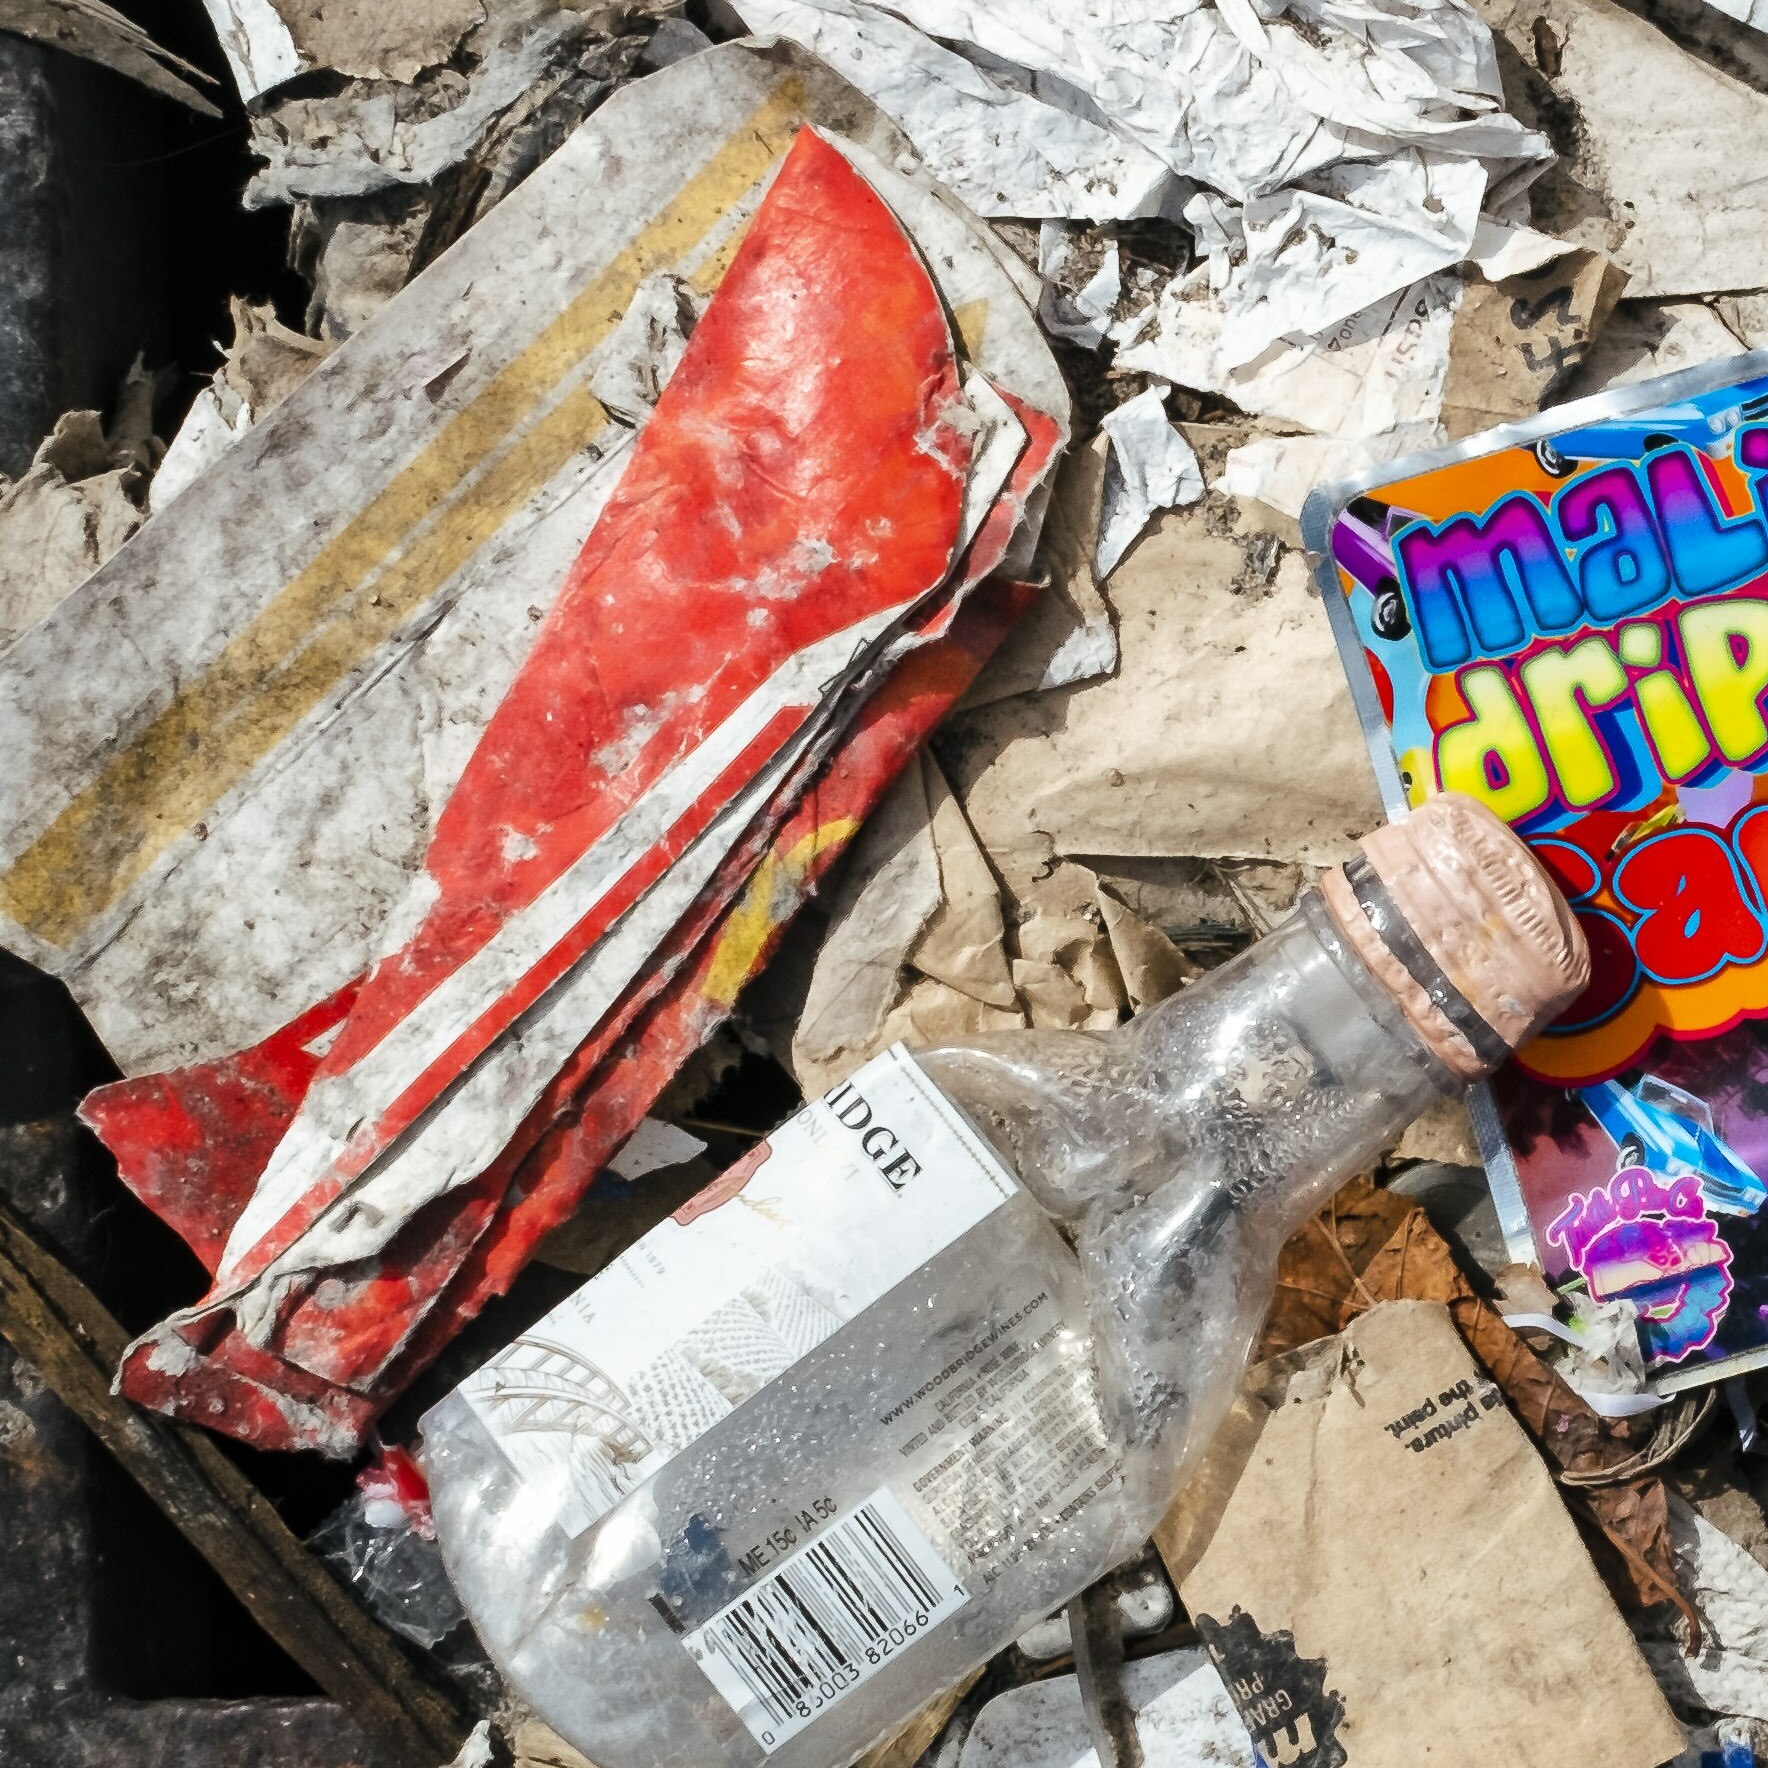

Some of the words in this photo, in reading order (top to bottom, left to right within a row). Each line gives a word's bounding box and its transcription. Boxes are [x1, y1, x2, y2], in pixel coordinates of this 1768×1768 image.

[824, 1080, 923, 1193] IDGE
[876, 1290, 1052, 1427] WWW.WOODBRIDGEWINES.COM
[736, 1544, 771, 1577] ME
[760, 1728, 777, 1747] 0
[862, 1607, 932, 1665] 82066
